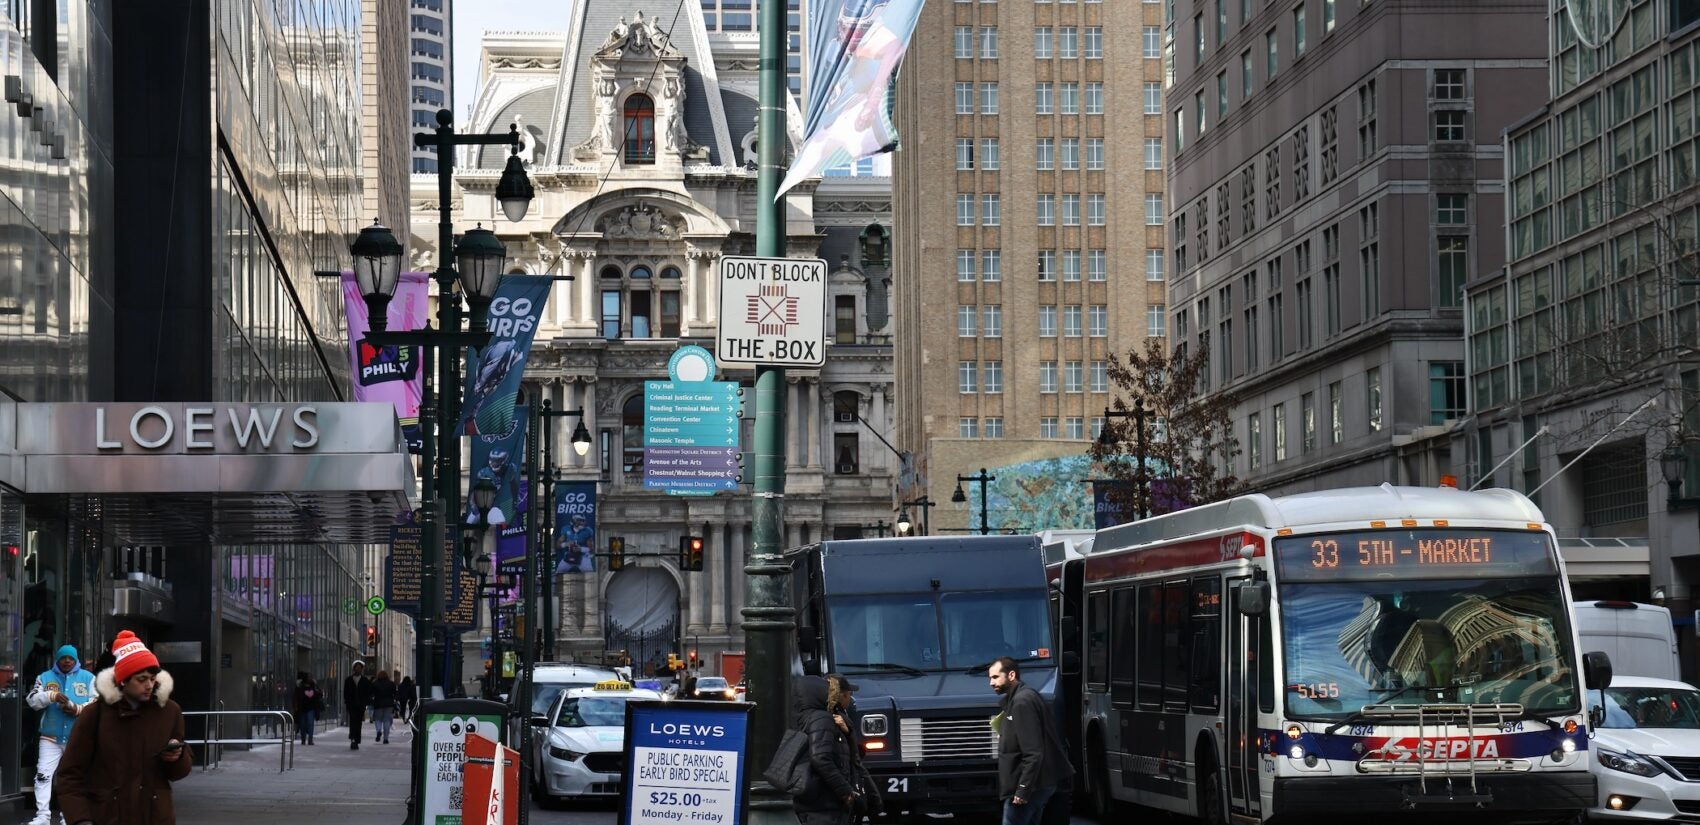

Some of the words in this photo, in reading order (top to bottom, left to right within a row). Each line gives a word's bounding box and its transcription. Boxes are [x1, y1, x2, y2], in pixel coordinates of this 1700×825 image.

[773, 264, 820, 282] BLOCK
[490, 296, 532, 317] GO
[726, 338, 764, 358] THE
[775, 340, 816, 361] BOX
[649, 405, 673, 413] Reading
[96, 405, 320, 450] LOEWS
[674, 437, 695, 445] Temple
[697, 470, 725, 478] Shopping
[565, 493, 587, 503] GO
[557, 503, 595, 514] BIRDS
[1311, 540, 1339, 568] 33
[1358, 540, 1394, 565] 5TH
[1418, 538, 1491, 564] MARKET
[1298, 682, 1339, 699] 5155
[650, 722, 725, 738] LOEWS
[1349, 724, 1375, 736] 7374
[433, 742, 454, 752] OVER
[438, 762, 452, 772] SEE
[647, 752, 680, 767] PUBLIC
[682, 754, 724, 769] PARKING
[437, 772, 458, 782] EACH
[640, 766, 667, 780] EARLY
[669, 767, 691, 782] BIRD
[693, 769, 730, 783] SPECIAL
[887, 777, 909, 793] 21
[650, 791, 702, 807] $25.00
[641, 808, 683, 821] Monday
[691, 811, 724, 824] Friday
